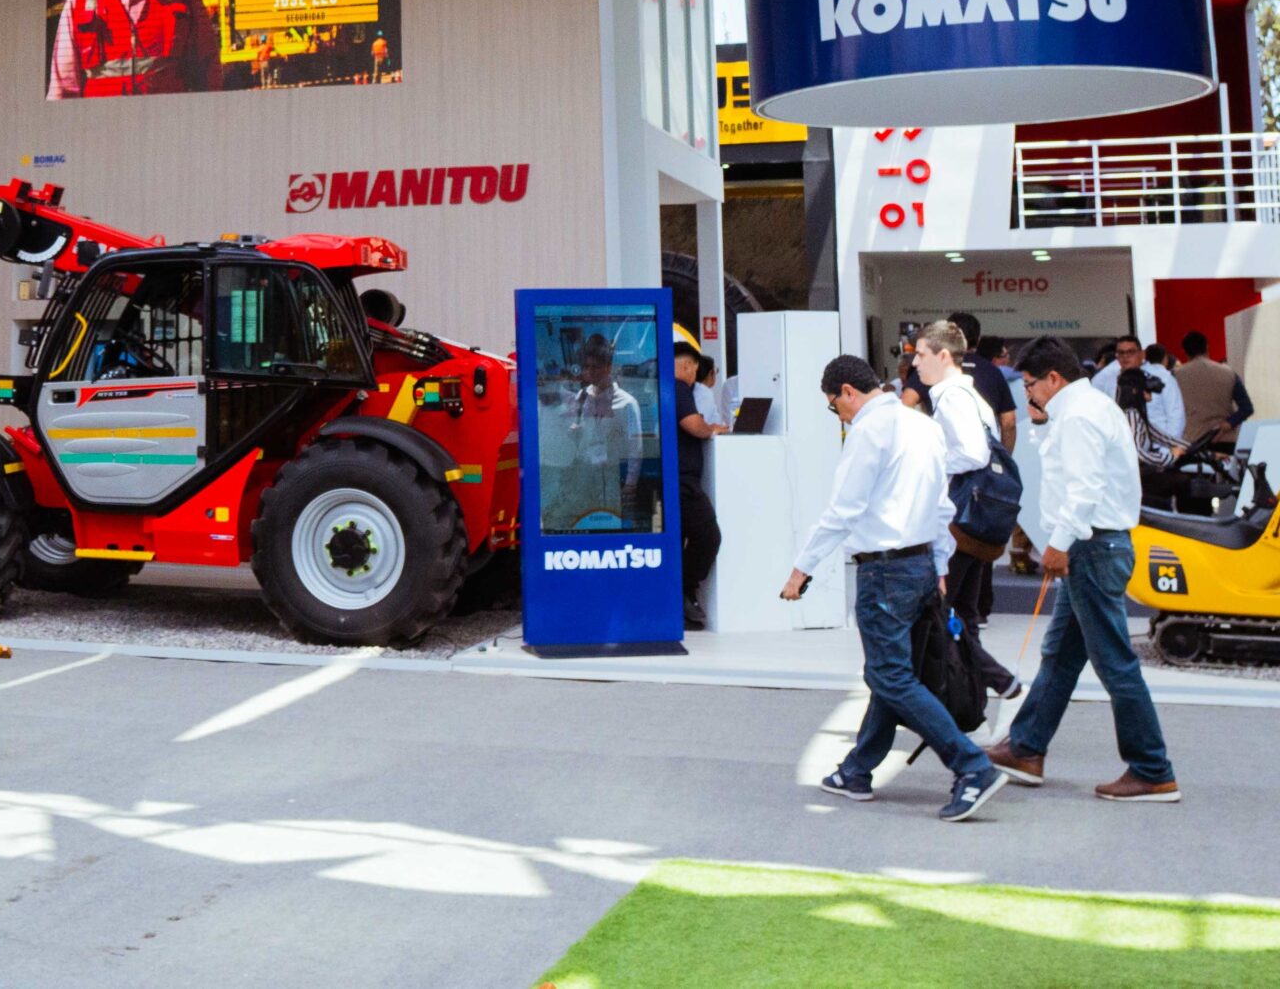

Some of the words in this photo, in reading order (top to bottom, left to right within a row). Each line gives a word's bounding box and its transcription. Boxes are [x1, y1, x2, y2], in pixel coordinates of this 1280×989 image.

[286, 12, 326, 22] SEGURIDAD
[719, 119, 764, 135] Together
[328, 164, 530, 210] MANITOU
[962, 270, 1049, 297] fireno
[1028, 319, 1081, 330] SIEMENS
[544, 544, 662, 571] KOMATSU
[1157, 577, 1178, 592] 01
